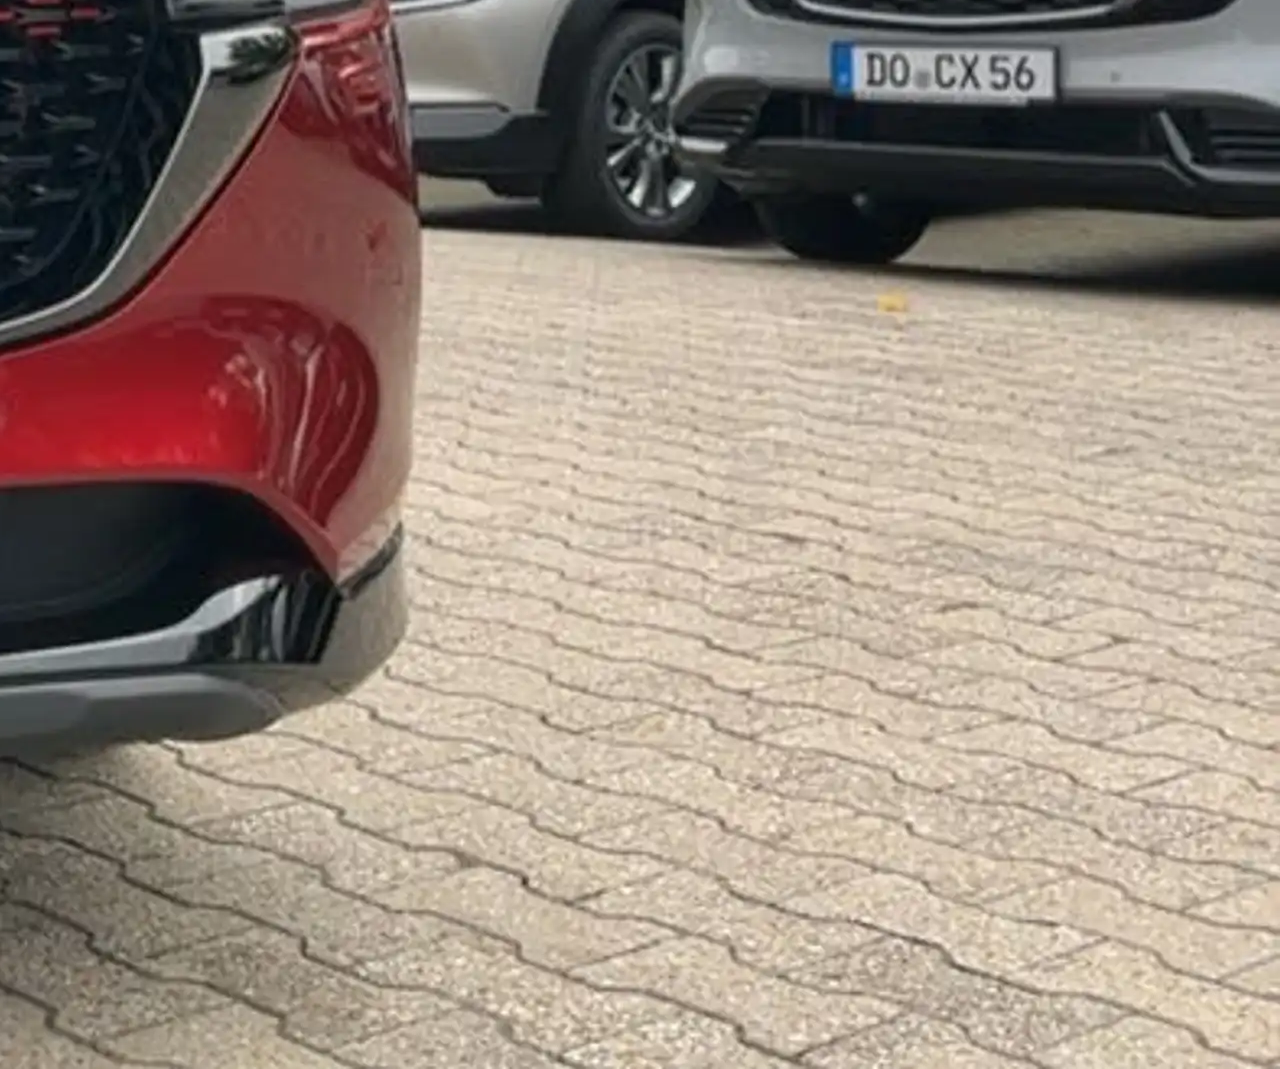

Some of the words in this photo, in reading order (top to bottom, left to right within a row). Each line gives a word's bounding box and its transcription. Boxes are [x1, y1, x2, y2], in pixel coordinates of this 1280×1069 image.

[866, 52, 910, 89] DO
[934, 53, 982, 90] CX
[989, 55, 1036, 92] 56
